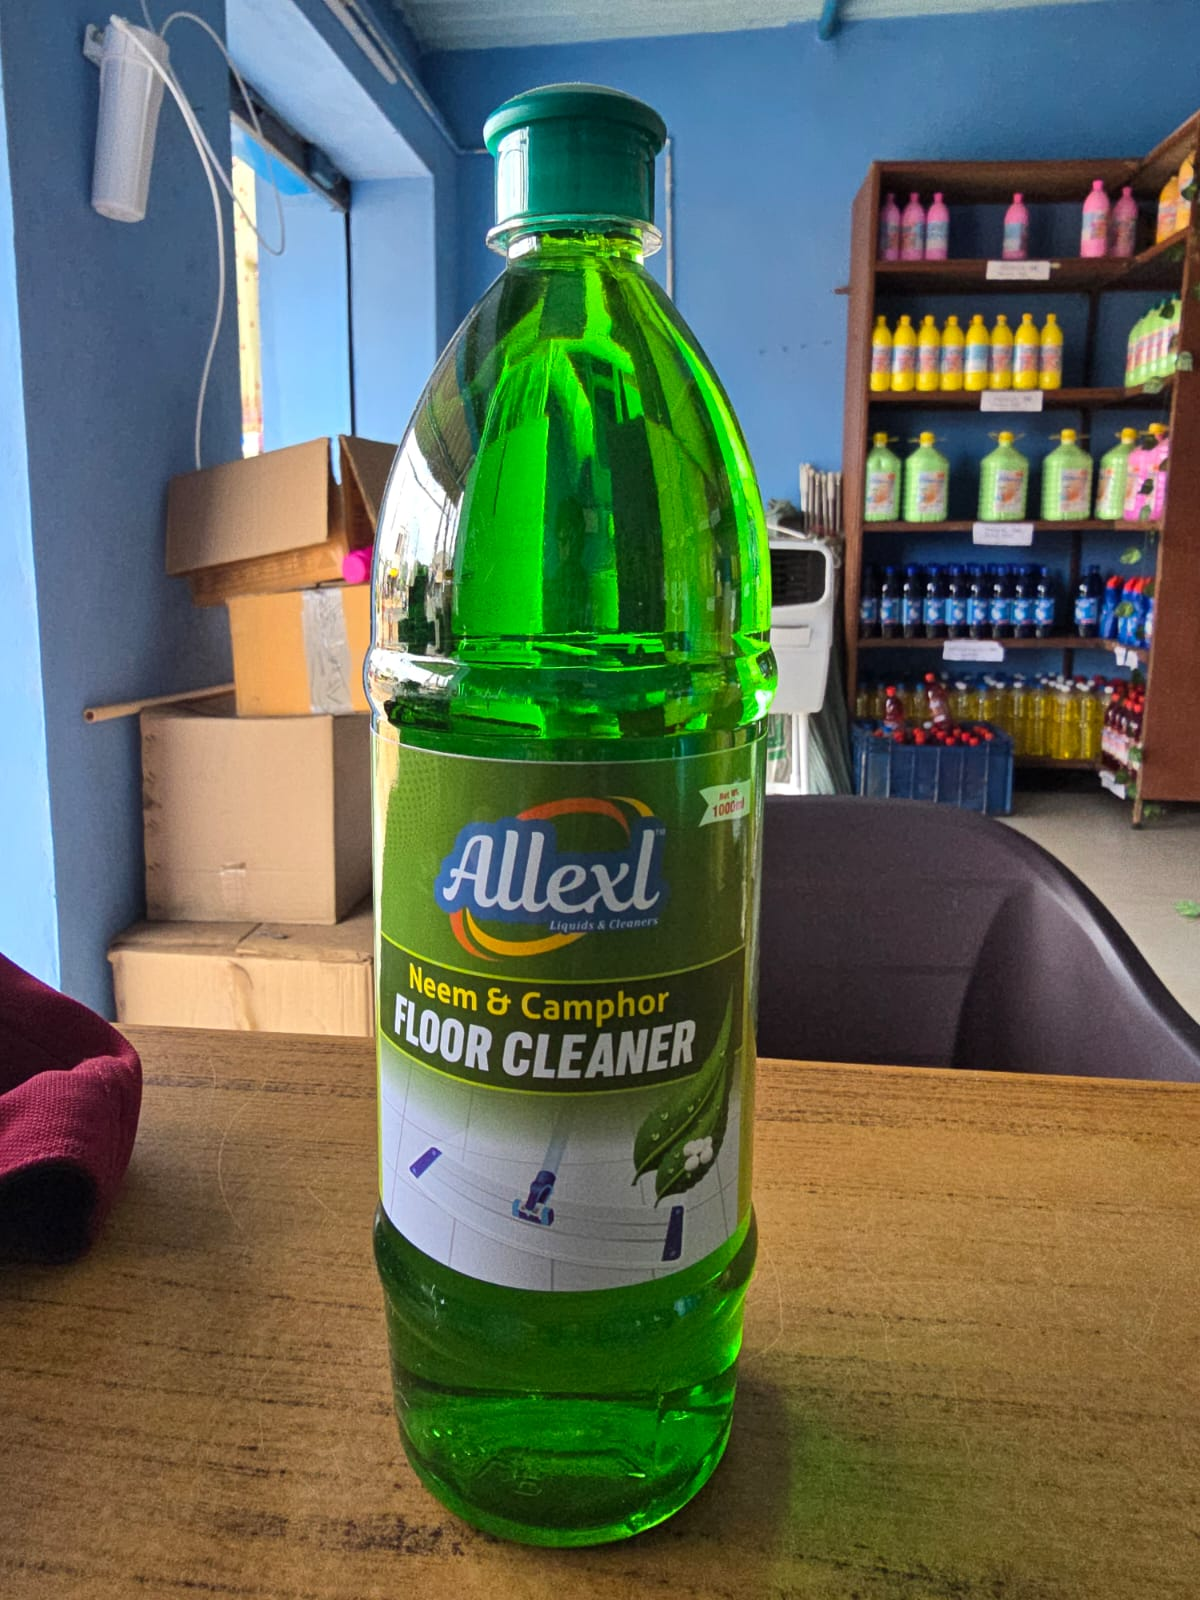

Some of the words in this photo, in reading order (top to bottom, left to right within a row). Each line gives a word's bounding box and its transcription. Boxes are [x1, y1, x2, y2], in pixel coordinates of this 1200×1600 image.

[442, 829, 660, 914] Allexl
[549, 918, 595, 933] Liquids
[597, 918, 607, 930] &
[608, 917, 660, 930] Cleaners
[409, 962, 478, 1015] Neem
[486, 987, 512, 1016] &
[521, 990, 670, 1028] Camphor
[394, 993, 493, 1072] FLOOR
[502, 1018, 697, 1080] CLEANER
